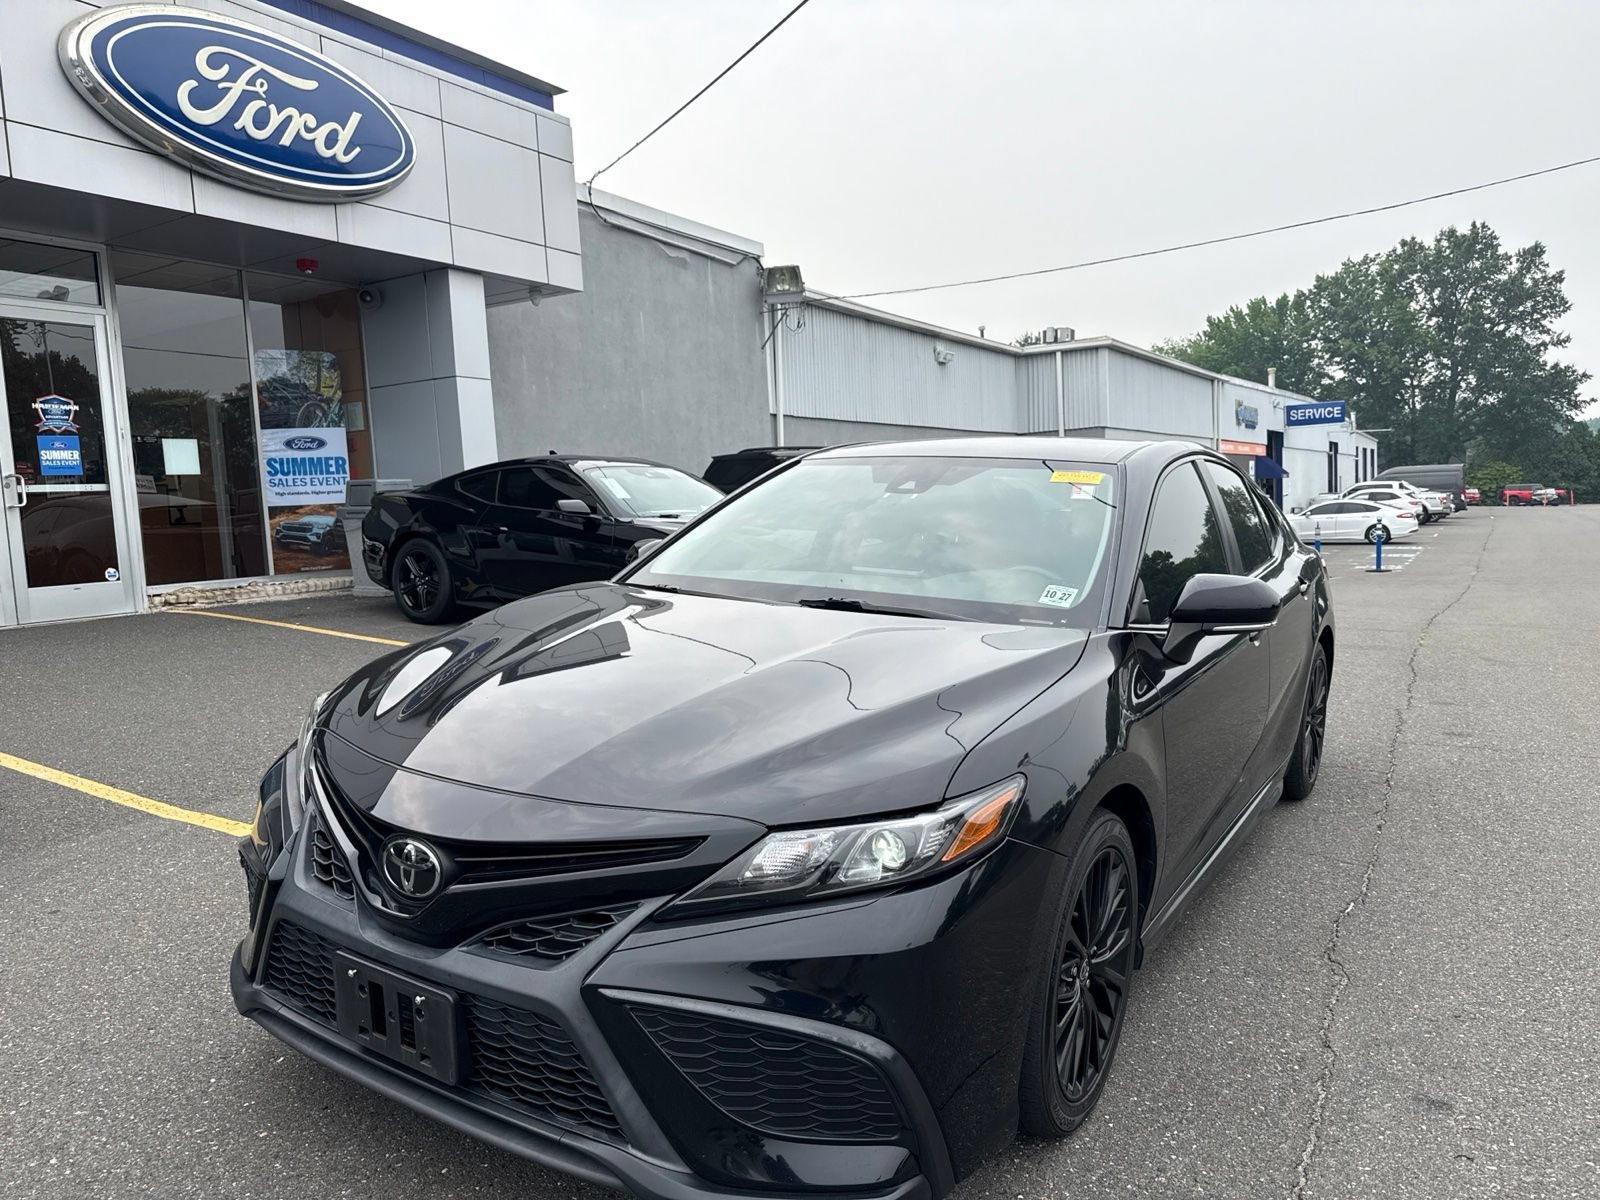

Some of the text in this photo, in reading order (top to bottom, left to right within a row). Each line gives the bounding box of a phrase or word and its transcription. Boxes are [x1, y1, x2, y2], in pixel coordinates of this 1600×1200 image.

[176, 45, 363, 164] Ford
[1289, 406, 1342, 421] SERVICE
[292, 438, 319, 449] Ford
[40, 450, 80, 460] SUMMER
[266, 456, 348, 477] SUMMER
[268, 476, 348, 488] SALES EVENT
[1044, 590, 1072, 601] 10 27
